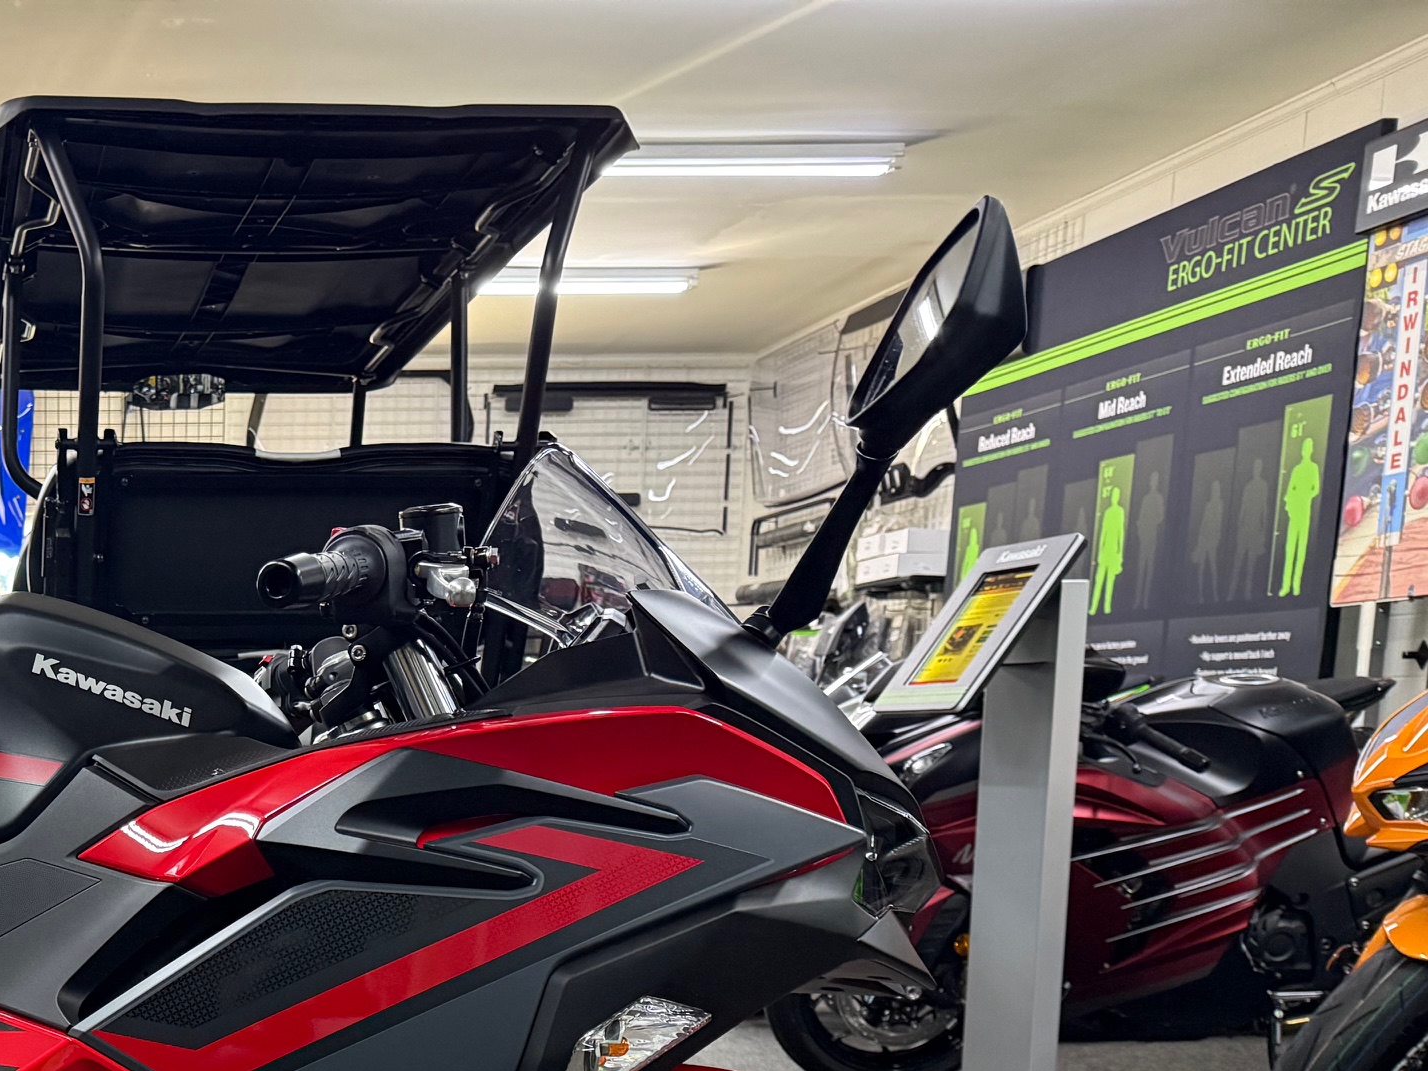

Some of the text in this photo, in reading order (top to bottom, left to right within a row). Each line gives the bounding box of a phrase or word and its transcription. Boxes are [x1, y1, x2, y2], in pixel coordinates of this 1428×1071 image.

[1159, 192, 1291, 264] Vulcan
[1167, 207, 1333, 292] ERGO-FIT CENTER
[1222, 344, 1313, 386] Extended Reach
[1246, 328, 1291, 350] ERGO-FIT
[1389, 266, 1419, 470] IRWINDALE
[1097, 391, 1147, 420] Mid Reach
[31, 652, 193, 728] Kawasaki
